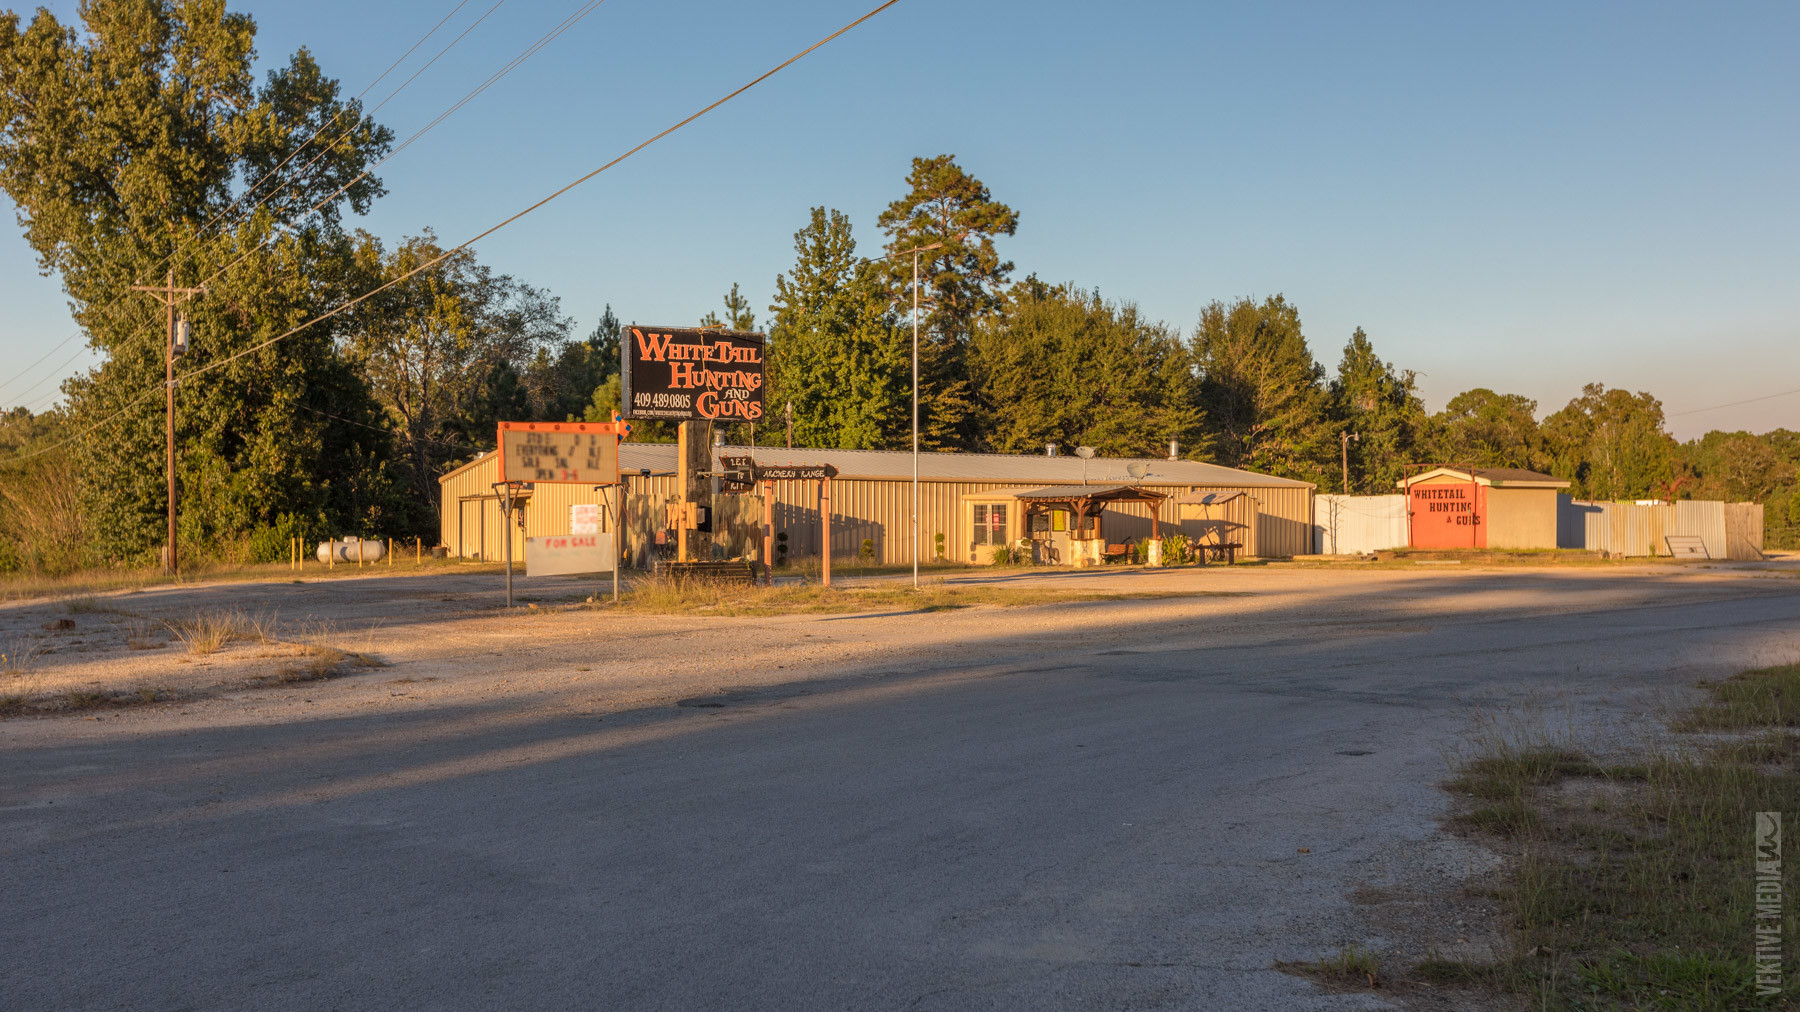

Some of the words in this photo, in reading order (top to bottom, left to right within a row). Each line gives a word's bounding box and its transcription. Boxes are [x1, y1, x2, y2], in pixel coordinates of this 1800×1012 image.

[668, 361, 762, 391] HUNTING
[634, 392, 691, 408] 409.489.0805
[723, 388, 750, 400] AND
[695, 391, 762, 419] GUNS
[763, 470, 796, 478] ARCHERY
[801, 470, 825, 478] RANGE
[1414, 489, 1465, 499] WHITETAIL
[545, 539, 568, 549] FOR
